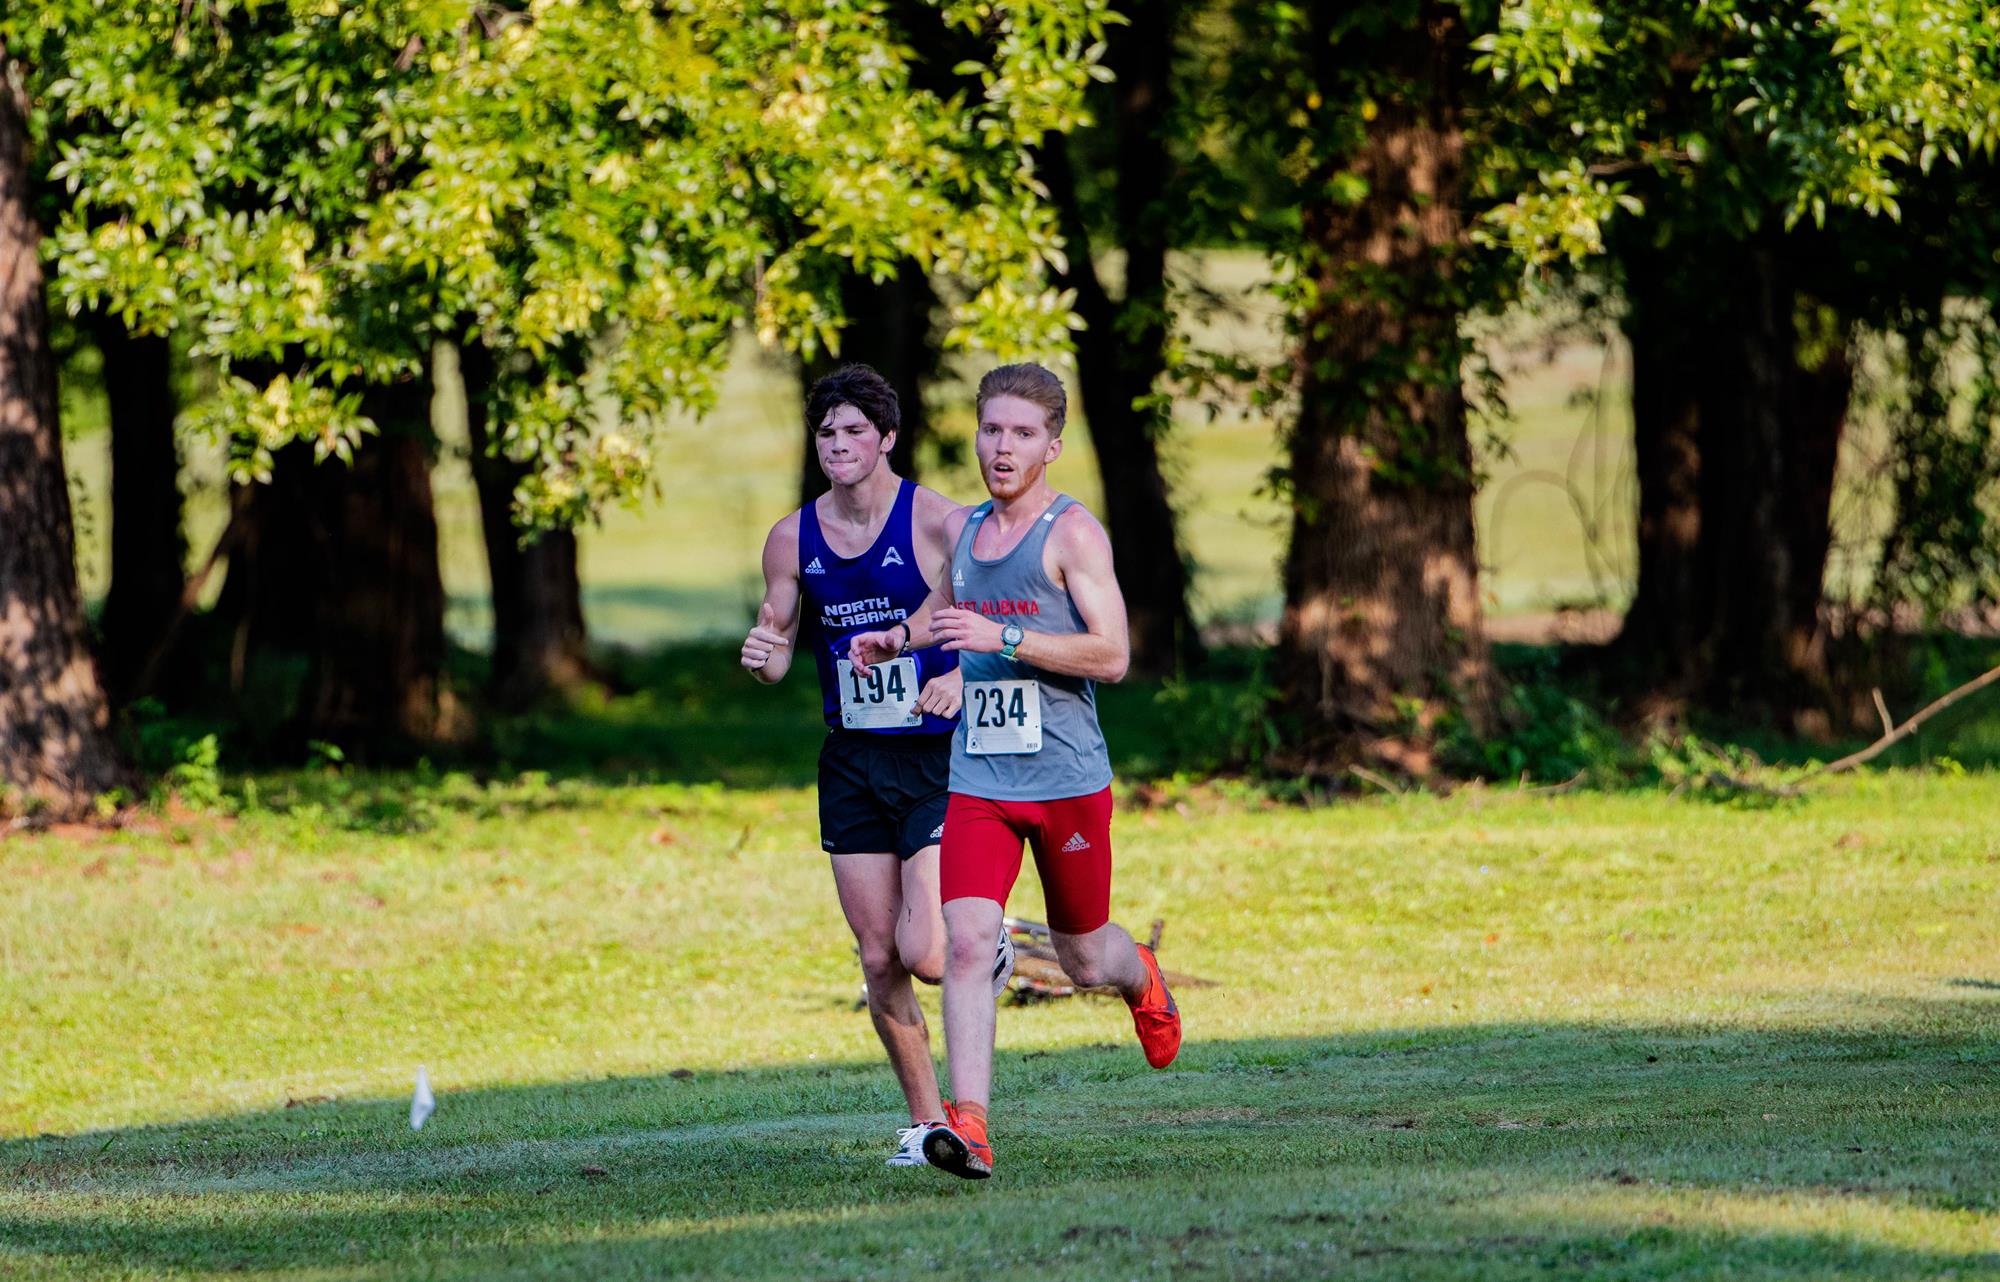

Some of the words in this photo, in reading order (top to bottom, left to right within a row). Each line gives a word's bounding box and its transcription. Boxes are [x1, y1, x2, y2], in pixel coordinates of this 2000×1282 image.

[824, 597, 890, 616] NORTH
[957, 601, 977, 613] EST
[981, 600, 1040, 615] ALABAMA
[820, 608, 908, 627] ALABAMA
[849, 664, 906, 704] 194
[974, 687, 1027, 727] 234
